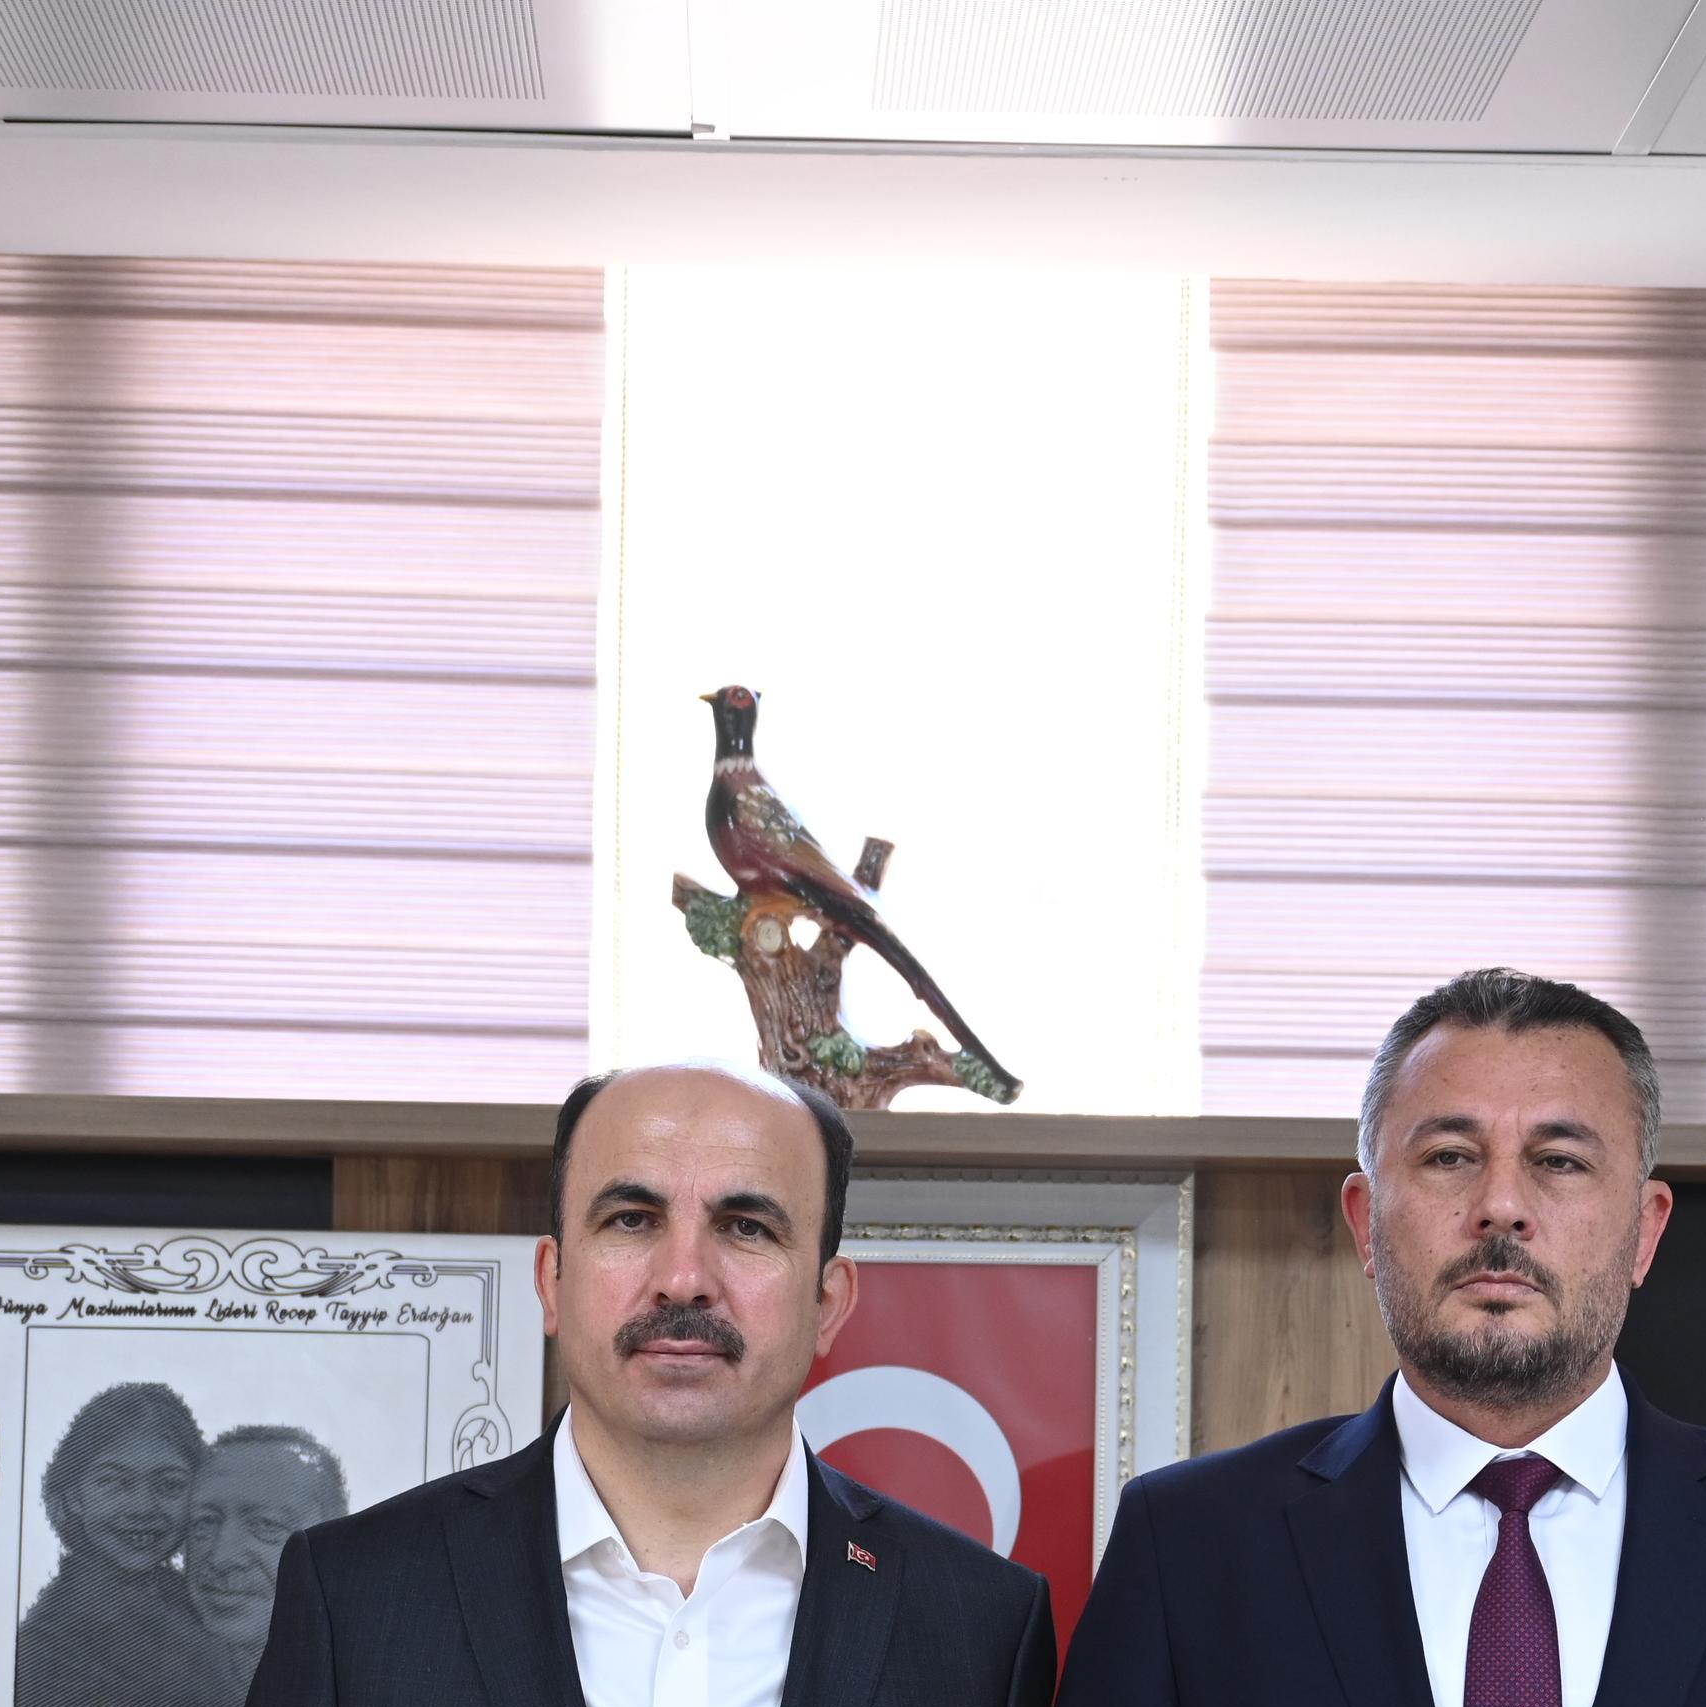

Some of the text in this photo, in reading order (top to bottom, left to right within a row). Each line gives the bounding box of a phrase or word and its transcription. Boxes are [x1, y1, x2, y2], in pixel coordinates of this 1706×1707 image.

[56, 1296, 197, 1321] Mazlumlarının
[205, 1298, 257, 1323] Lideri
[265, 1300, 317, 1326] Recep
[326, 1301, 389, 1331] Tayyip
[396, 1303, 474, 1332] Erdoğan
